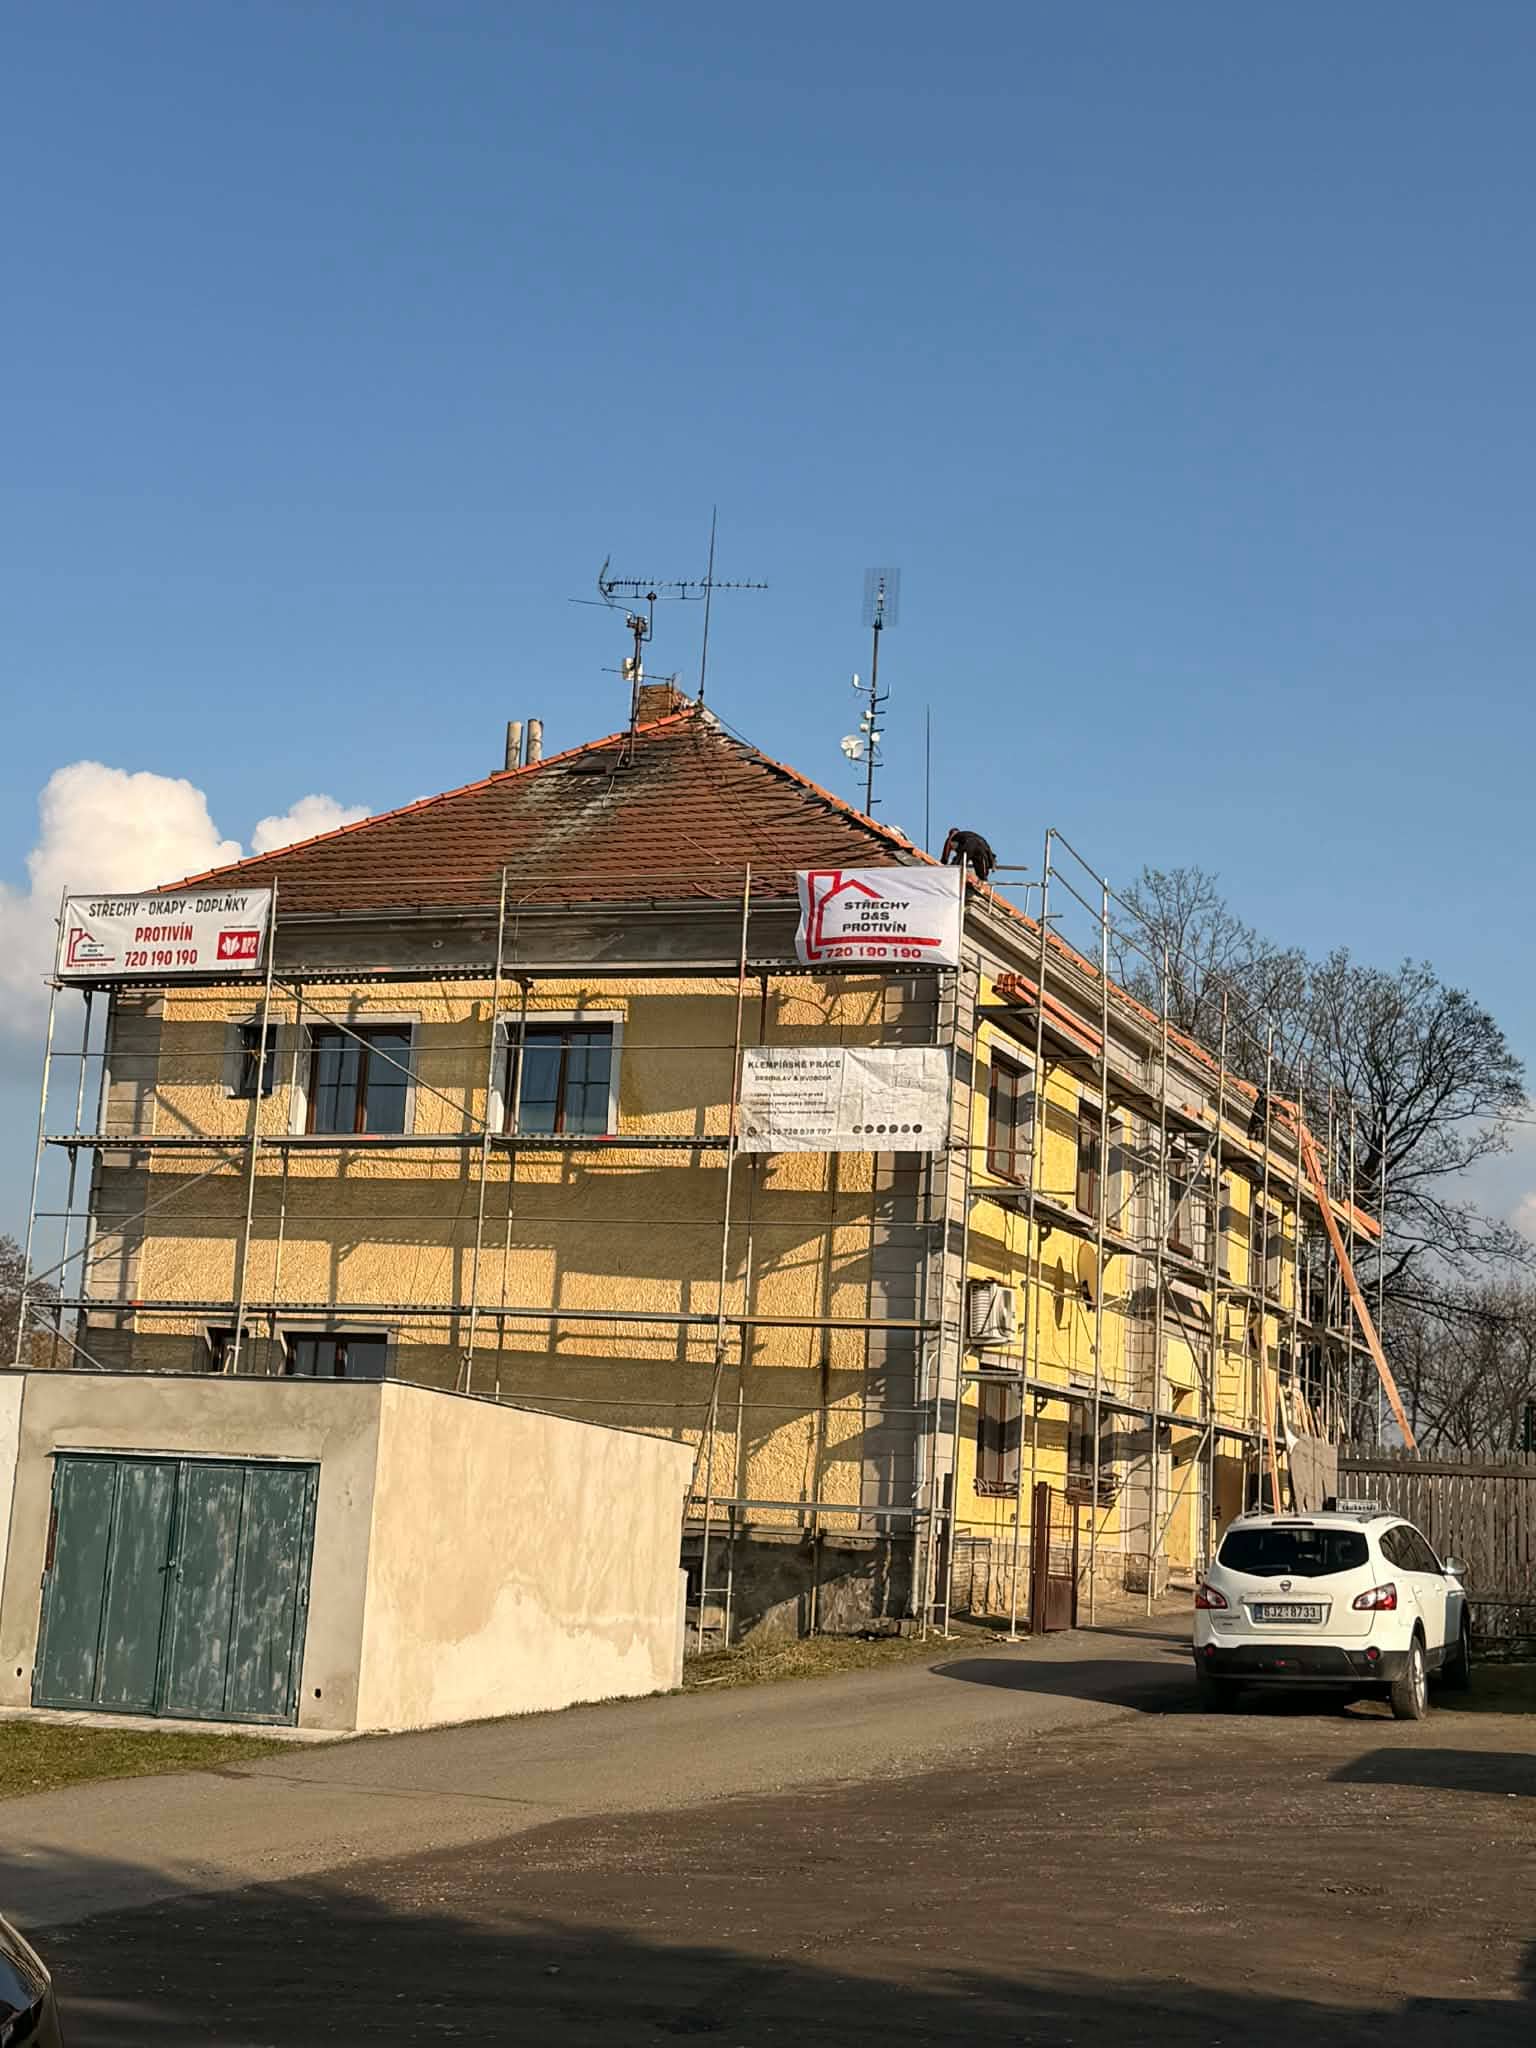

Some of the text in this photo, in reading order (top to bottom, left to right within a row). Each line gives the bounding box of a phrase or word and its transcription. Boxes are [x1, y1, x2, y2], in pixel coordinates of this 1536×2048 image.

[89, 900, 139, 917] STŘECHY
[149, 900, 187, 916] OKAPY
[195, 894, 248, 913] DOPLŇKY
[844, 899, 910, 910] STŘECHY
[861, 911, 890, 921] D&S
[135, 922, 193, 943] PROTIVÍN
[842, 921, 907, 933] PROTIVÍN
[125, 949, 198, 967] 720 190 190
[826, 947, 922, 958] 720 190 190
[1290, 1606, 1316, 1617] 8733
